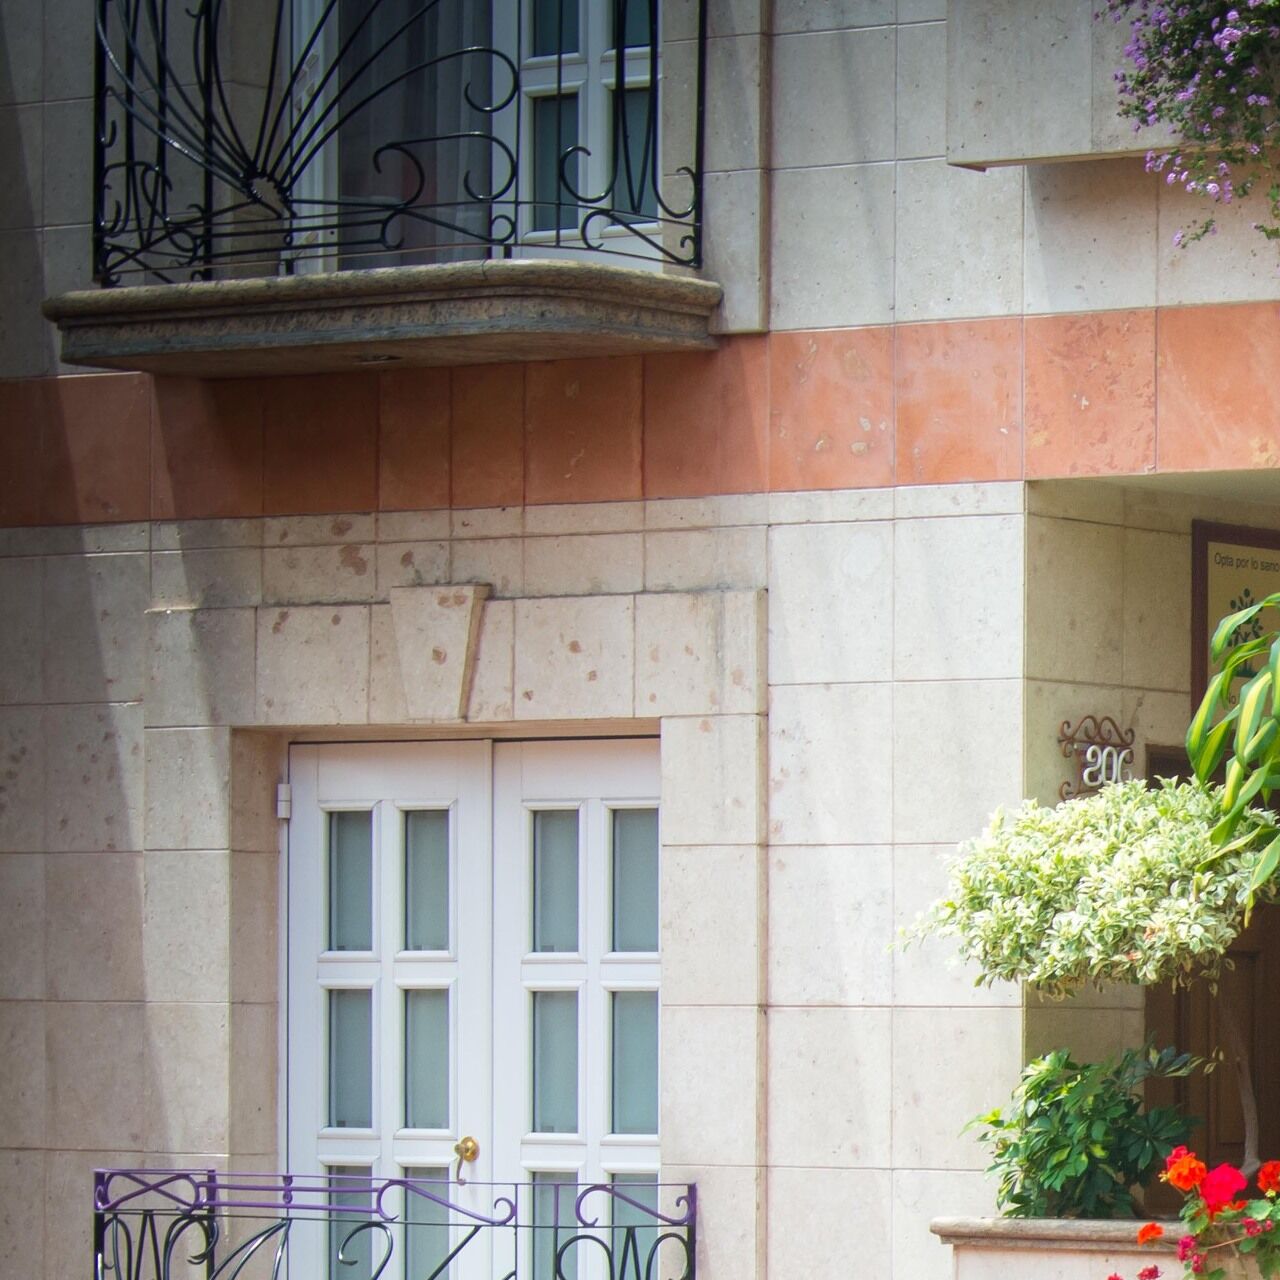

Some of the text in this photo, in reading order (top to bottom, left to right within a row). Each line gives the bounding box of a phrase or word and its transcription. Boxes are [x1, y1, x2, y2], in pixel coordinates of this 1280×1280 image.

[1214, 552, 1280, 573] Opta por lo sano
